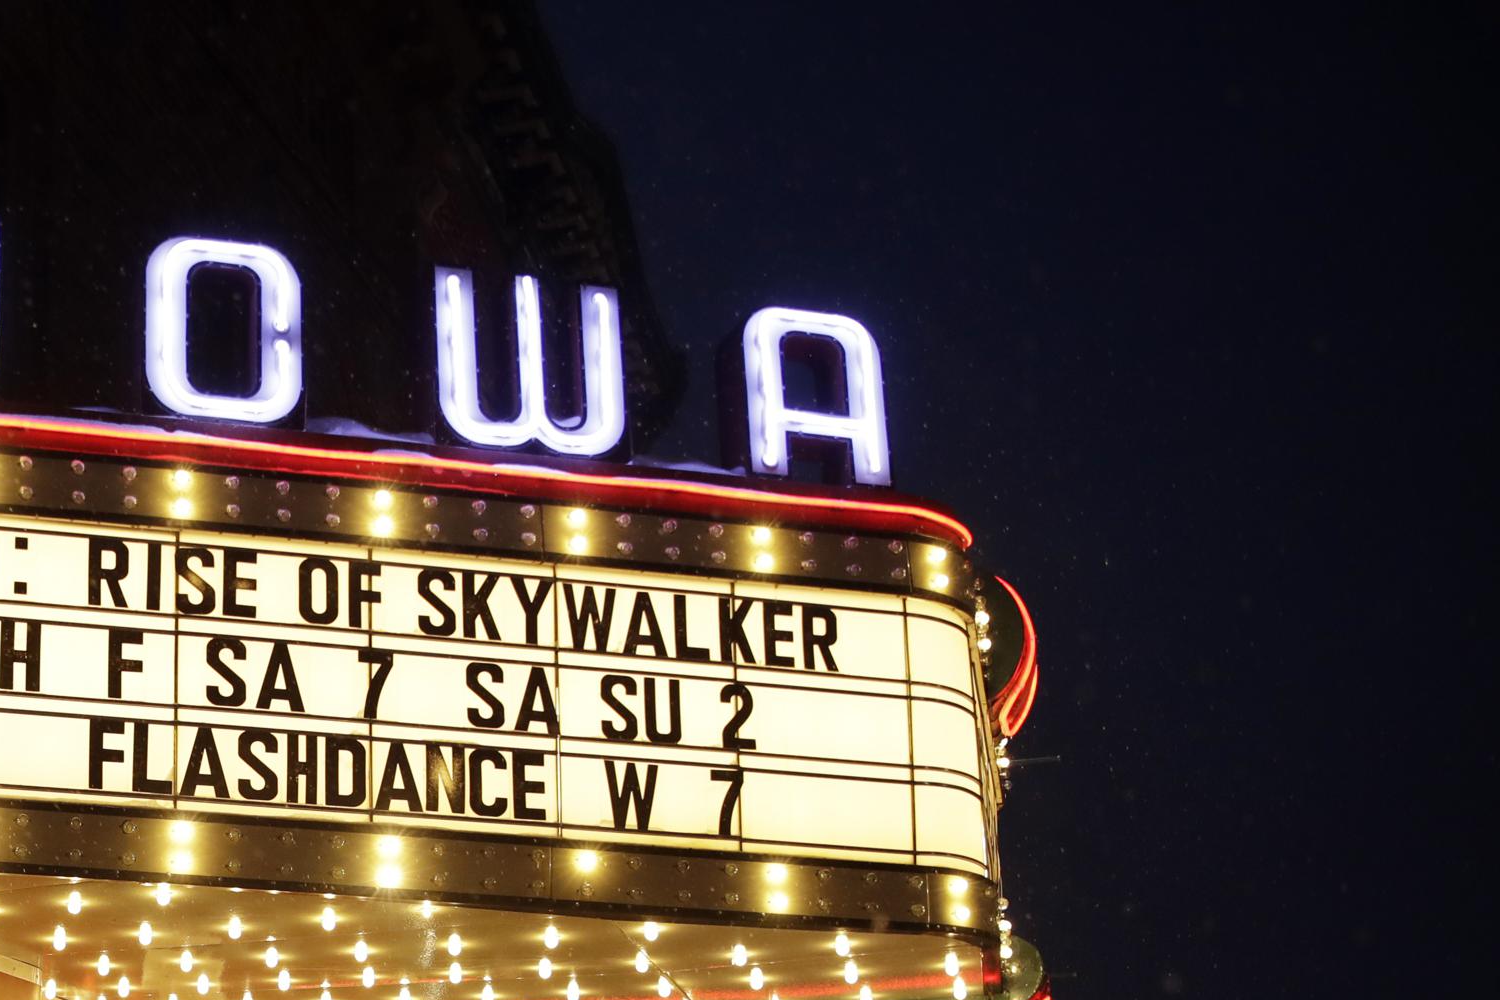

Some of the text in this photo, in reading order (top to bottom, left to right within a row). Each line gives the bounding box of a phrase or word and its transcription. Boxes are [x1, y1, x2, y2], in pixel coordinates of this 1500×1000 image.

[88, 537, 257, 618] RISE
[299, 558, 382, 629] OF
[417, 567, 838, 673] SKYWALKER
[108, 628, 144, 699] F
[205, 636, 305, 713] SA
[358, 650, 393, 719] 7
[465, 661, 560, 736] SA
[601, 674, 682, 745] SU
[719, 684, 757, 750] 2
[88, 716, 744, 836] FLASHDANCE W 7
